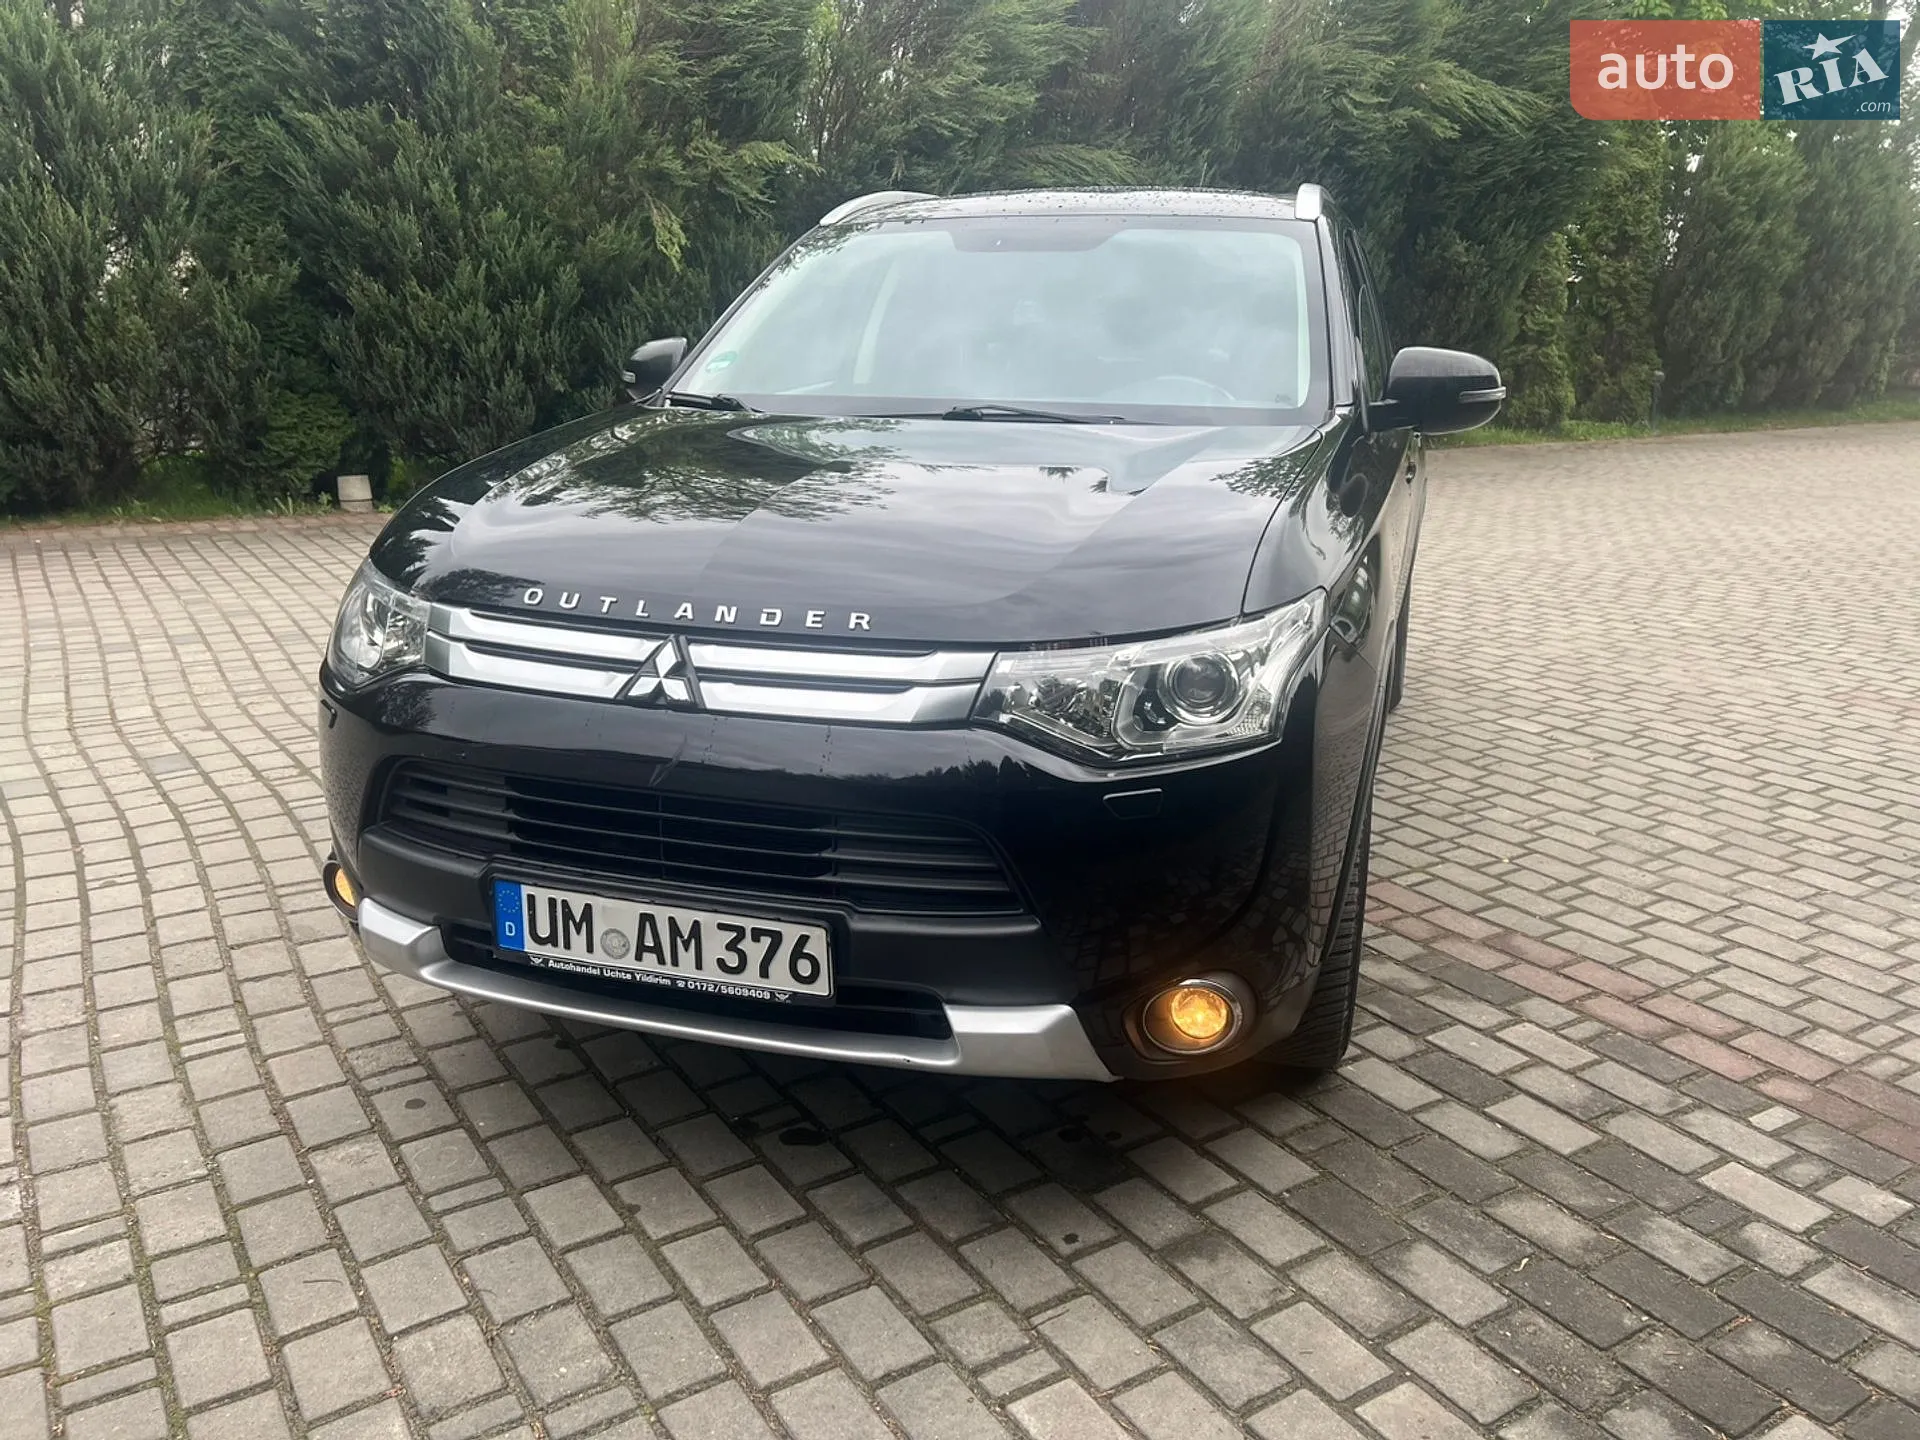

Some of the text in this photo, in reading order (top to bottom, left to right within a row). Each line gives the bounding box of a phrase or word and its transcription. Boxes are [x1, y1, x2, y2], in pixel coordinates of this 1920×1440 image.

[523, 587, 872, 631] OUTLANDER
[504, 921, 515, 937] D
[526, 892, 821, 985] UM AM 376
[548, 959, 600, 976] Autohandel
[602, 968, 632, 980] Uchte
[634, 973, 672, 987] Yildirim
